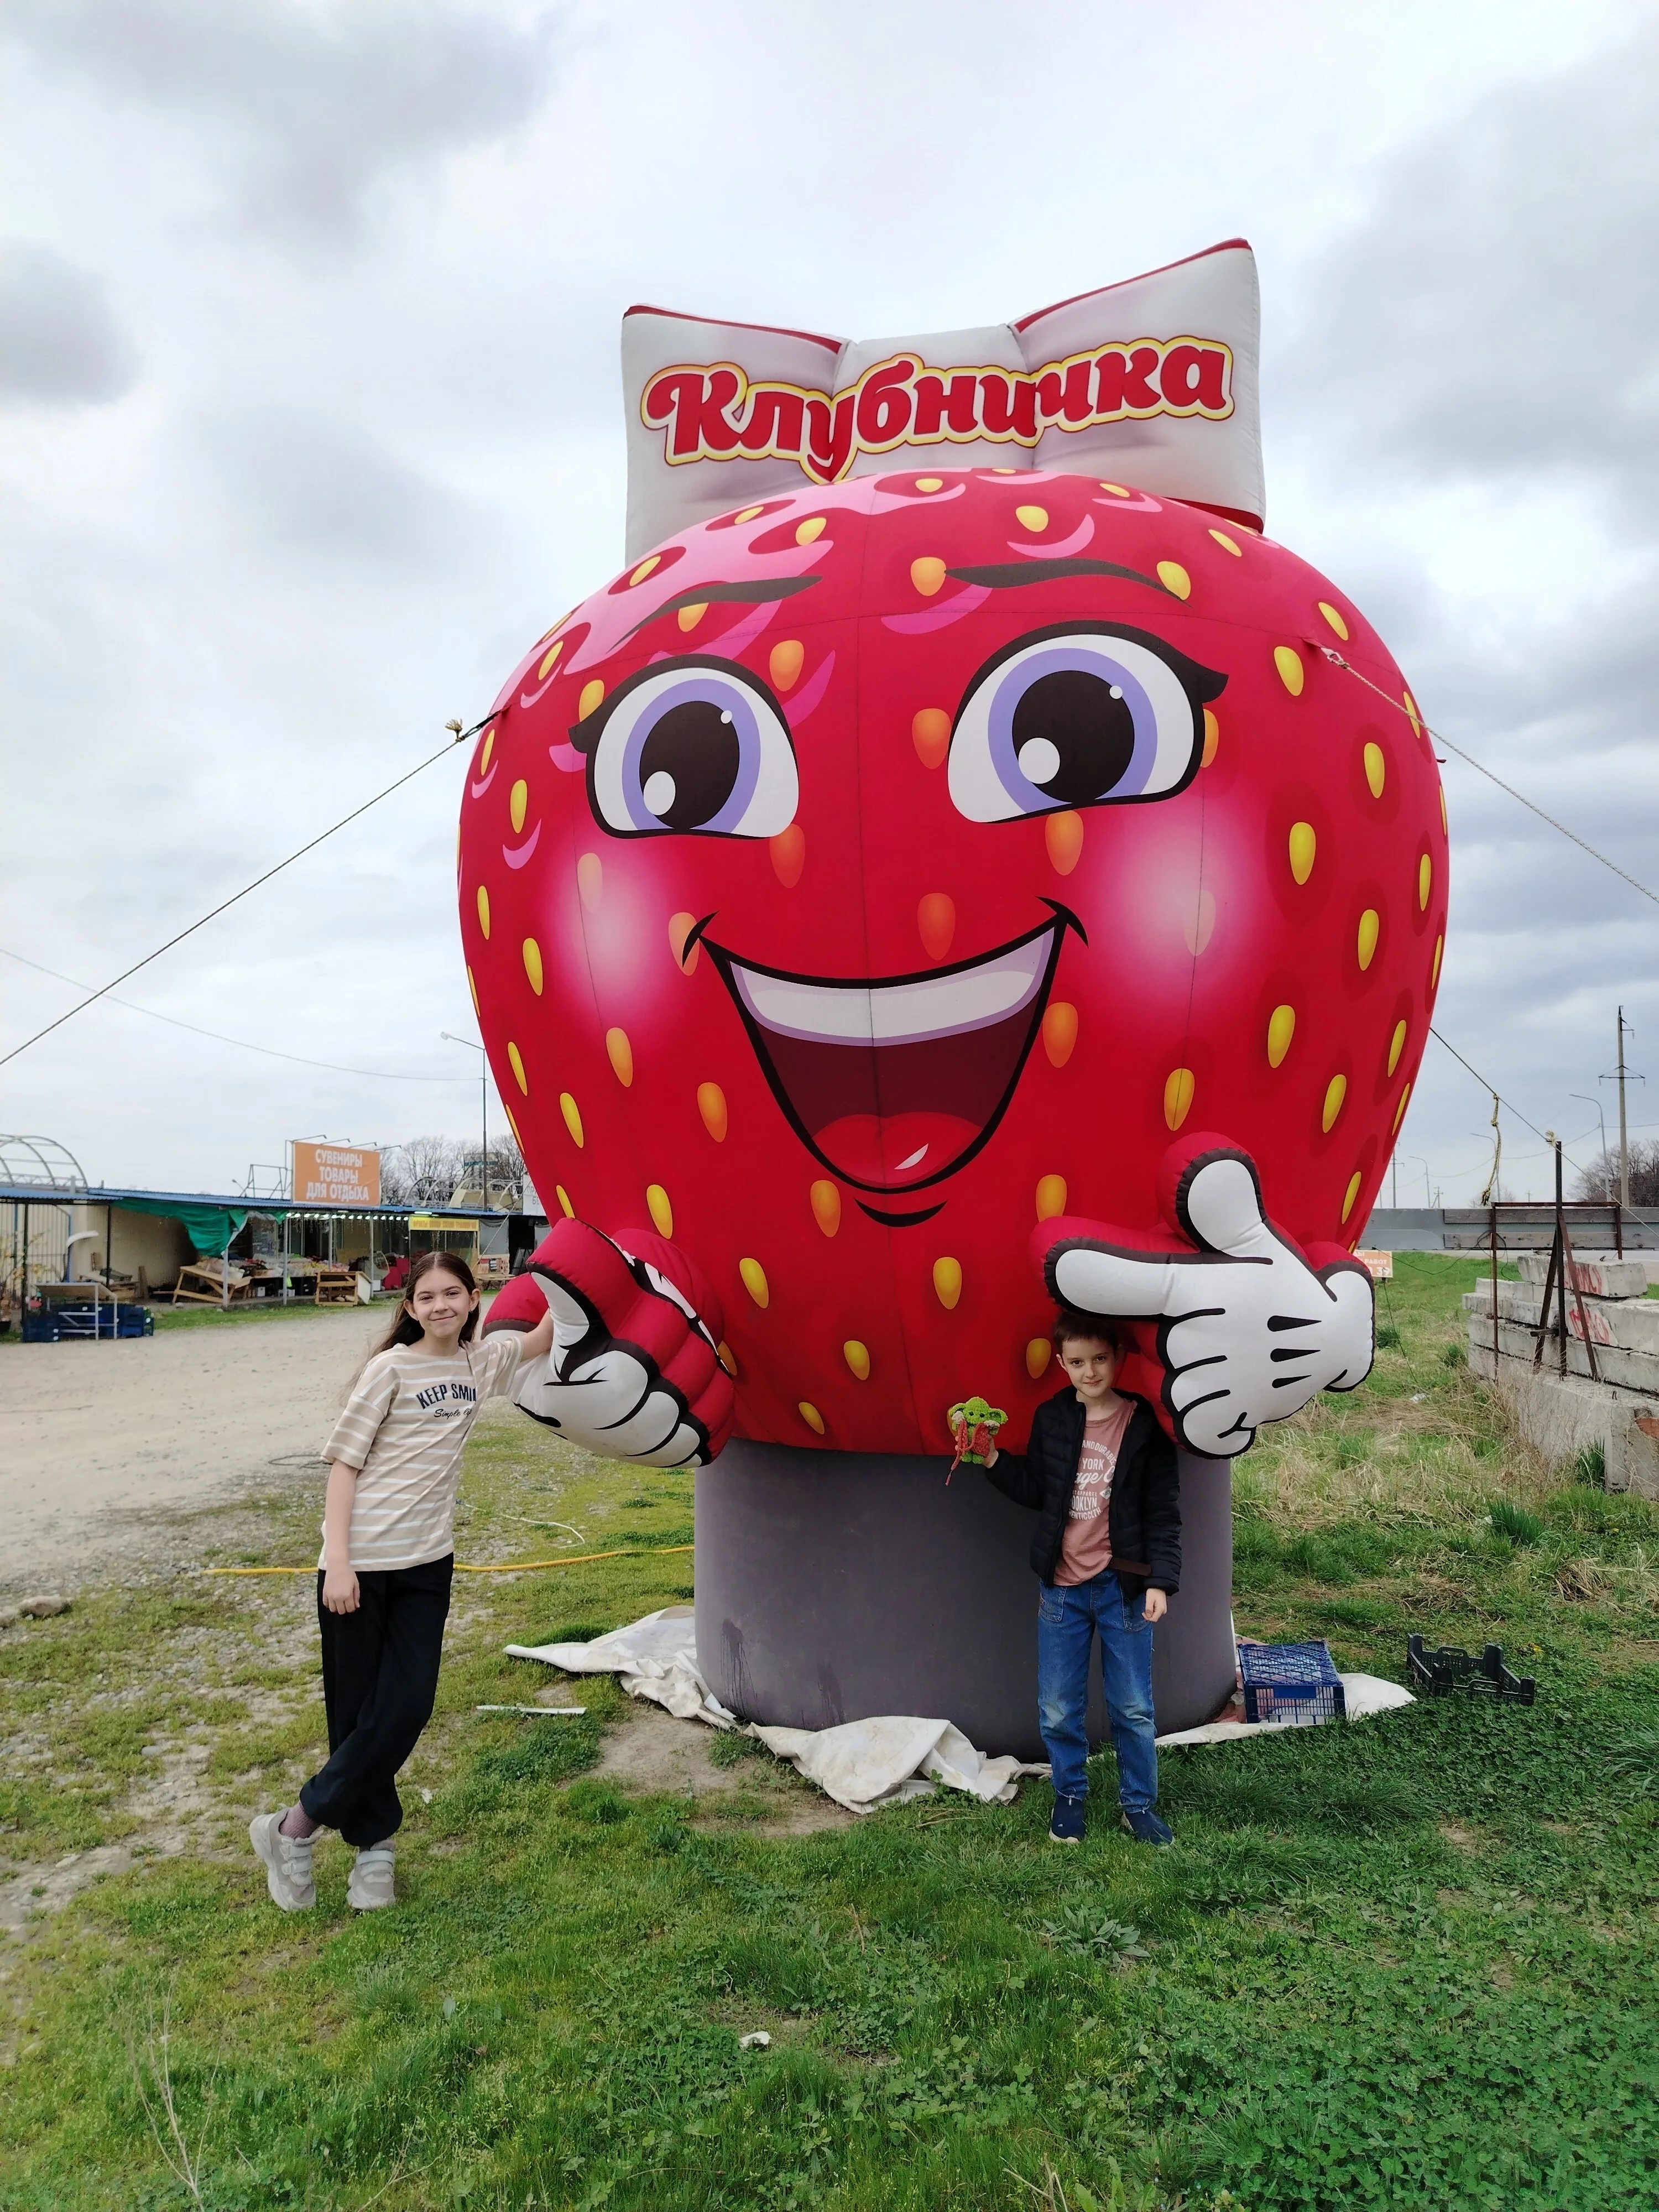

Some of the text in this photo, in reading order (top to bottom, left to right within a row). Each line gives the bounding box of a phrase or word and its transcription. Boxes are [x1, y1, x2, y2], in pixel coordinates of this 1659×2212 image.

[646, 344, 1228, 482] Клубничка
[315, 1149, 363, 1167] СУВЕНИРЫ
[319, 1166, 358, 1184] ТОВАРЫ
[306, 1182, 369, 1202] ДЛЯ ОТДЫХА
[416, 1384, 447, 1410] KEEP
[434, 1408, 461, 1420] Simple
[1082, 1457, 1105, 1470] YORK
